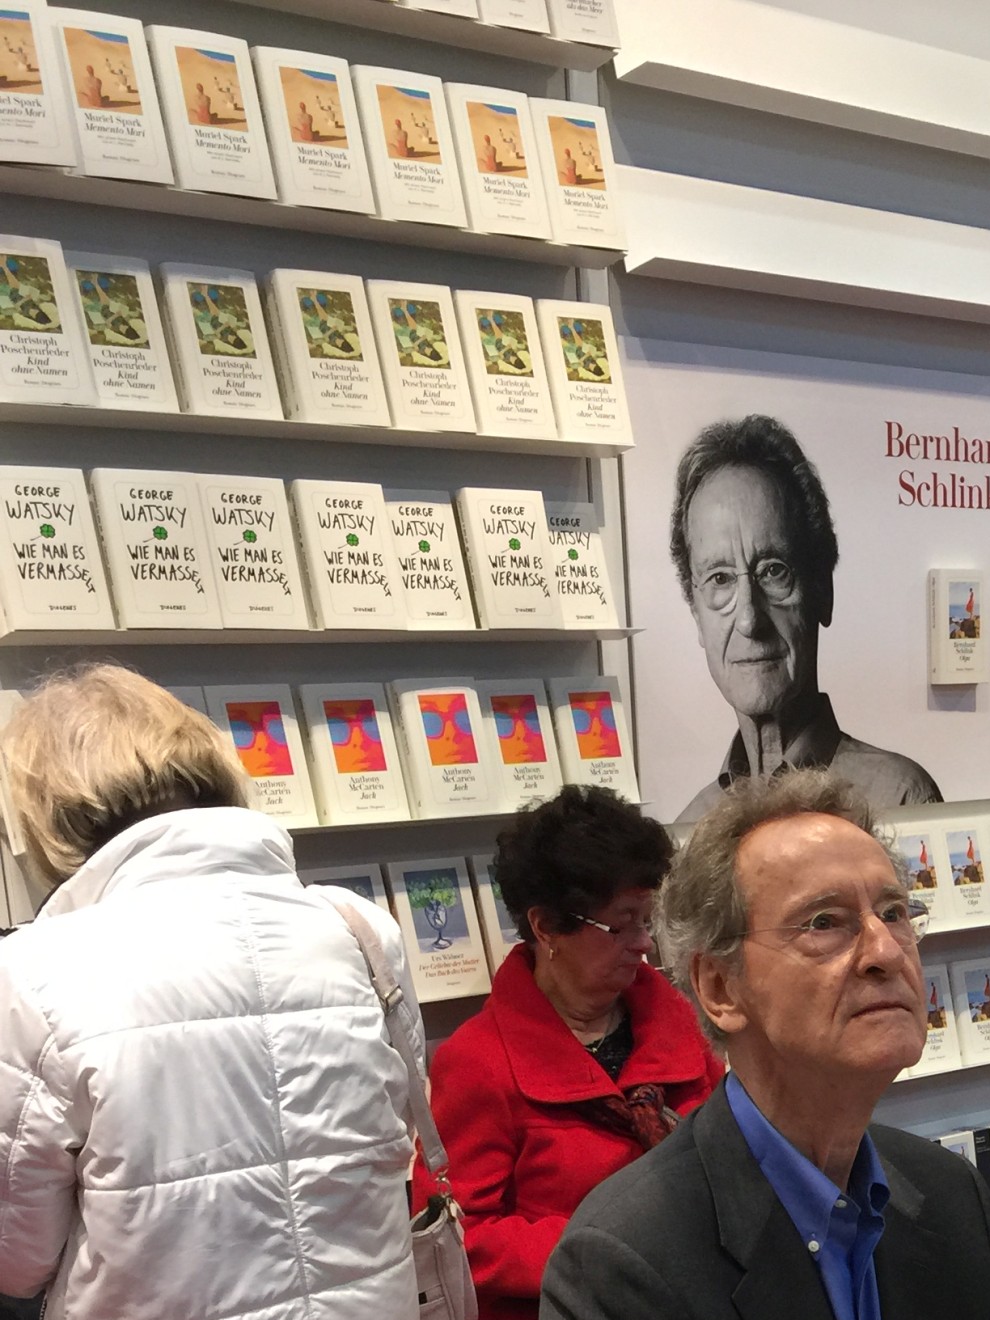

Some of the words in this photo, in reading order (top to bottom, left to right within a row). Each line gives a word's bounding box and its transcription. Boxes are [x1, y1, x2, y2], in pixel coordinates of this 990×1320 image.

[84, 112, 114, 124] Muriel
[116, 117, 142, 128] Spark
[85, 123, 124, 134] Memento
[126, 127, 146, 138] Mori
[9, 334, 58, 350] Christoph
[0, 344, 70, 358] Poschenrieder
[101, 350, 146, 365] Christoph
[27, 356, 50, 367] Kind
[93, 358, 157, 372] Poschenrieder
[210, 359, 253, 373] Christoph
[11, 365, 34, 374] ohne
[36, 366, 68, 377] Namen
[117, 370, 139, 380] Kind
[203, 368, 263, 381] Poschenrieder
[319, 362, 360, 376] Christoph
[225, 379, 246, 389] Kind
[311, 371, 370, 383] Poschenrieder
[409, 370, 448, 384] Christoph
[103, 380, 125, 388] ohne
[127, 380, 156, 391] Namen
[334, 382, 353, 390] Kind
[495, 378, 531, 391] Christoph
[212, 388, 233, 396] ohne
[234, 388, 262, 399] Namen
[320, 390, 340, 398] ohne
[341, 391, 369, 401] Namen
[422, 390, 441, 398] Kind
[508, 397, 524, 406] Kind
[15, 484, 61, 498] GEORGE
[129, 488, 174, 501] GEORGE
[220, 492, 263, 506] GEORGE
[325, 497, 363, 511] GEORGE
[5, 500, 75, 526] WATSKY
[120, 503, 187, 528] WATSKY
[398, 505, 434, 518] GEORGE
[490, 504, 525, 516] GEORGE
[212, 507, 275, 532] WATSKY
[317, 511, 375, 536] WATSKY
[549, 516, 581, 528] GEORGE
[391, 519, 445, 542] WATSKY
[483, 517, 536, 540] WATSKY
[13, 543, 37, 560] WIE
[41, 543, 68, 560] MAN
[72, 545, 86, 561] ES
[127, 544, 150, 560] WIE
[154, 545, 180, 561] MAN
[183, 546, 196, 562] ES
[218, 547, 240, 563] WIE
[243, 547, 268, 563] MAN
[271, 549, 283, 564] ES
[323, 550, 345, 566] WIE
[347, 551, 370, 566] MAN
[373, 552, 384, 567] ES
[399, 557, 418, 572] WIE
[420, 557, 441, 572] MAN
[443, 558, 454, 572] ES
[488, 554, 509, 569] WIE
[511, 554, 531, 569] MAN
[533, 555, 543, 570] ES
[17, 562, 96, 594] VERMASSELT
[130, 563, 205, 594] VERMASSELT
[569, 565, 587, 578] MAN
[590, 565, 600, 578] ES
[221, 565, 292, 596] VERMASSELT
[327, 568, 392, 597] VERMASSELT
[402, 574, 462, 601] VERMASSELT
[491, 571, 551, 598] VERMASSELT
[255, 780, 287, 789] Anthony
[350, 775, 380, 785] Anthony
[349, 783, 384, 792] McCarten
[265, 797, 283, 806] Jack
[360, 791, 376, 800] Jack
